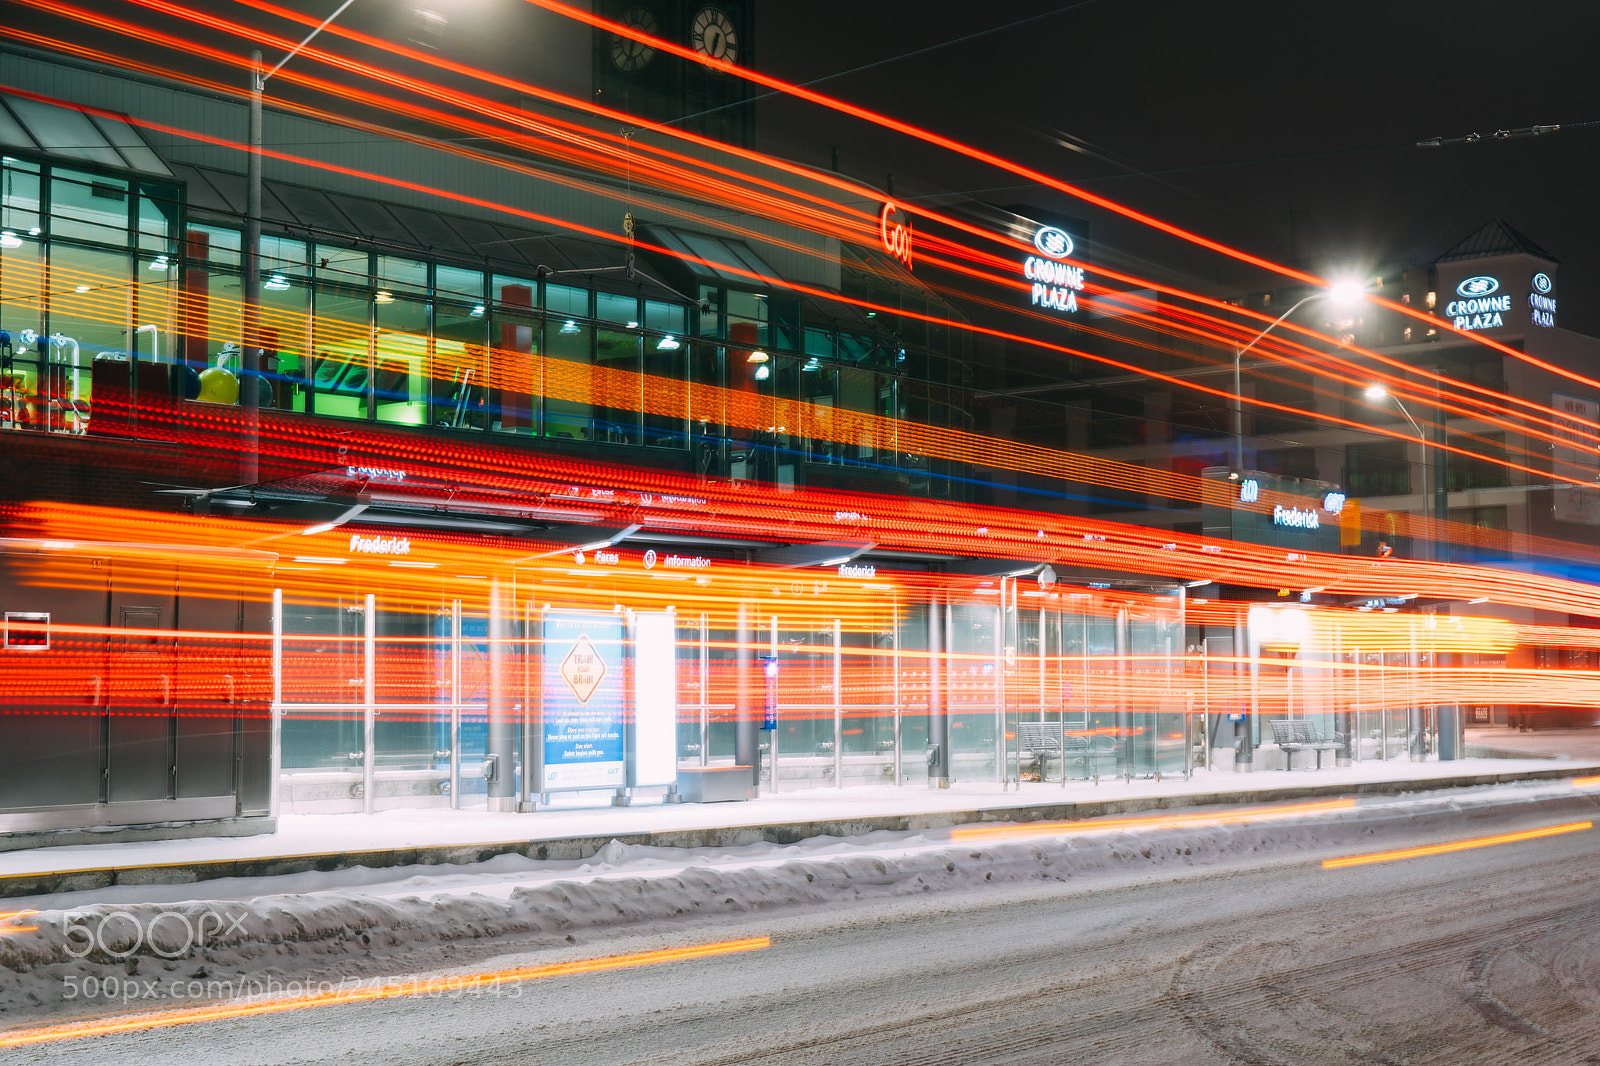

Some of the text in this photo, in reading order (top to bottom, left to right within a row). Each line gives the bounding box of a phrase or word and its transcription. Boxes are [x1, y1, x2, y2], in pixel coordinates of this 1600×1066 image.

[1024, 256, 1085, 290] CROWNE
[1032, 282, 1077, 313] PLAZA
[1446, 295, 1511, 317] CROWNE
[1528, 292, 1557, 313] CROWNE
[1454, 312, 1504, 331] PLAZA
[1531, 309, 1555, 328] PLAZA
[1273, 504, 1319, 529] Frederick
[349, 534, 410, 555] Frederick
[594, 550, 619, 565] Fares
[664, 555, 711, 568] Information
[838, 563, 876, 579] Frederick
